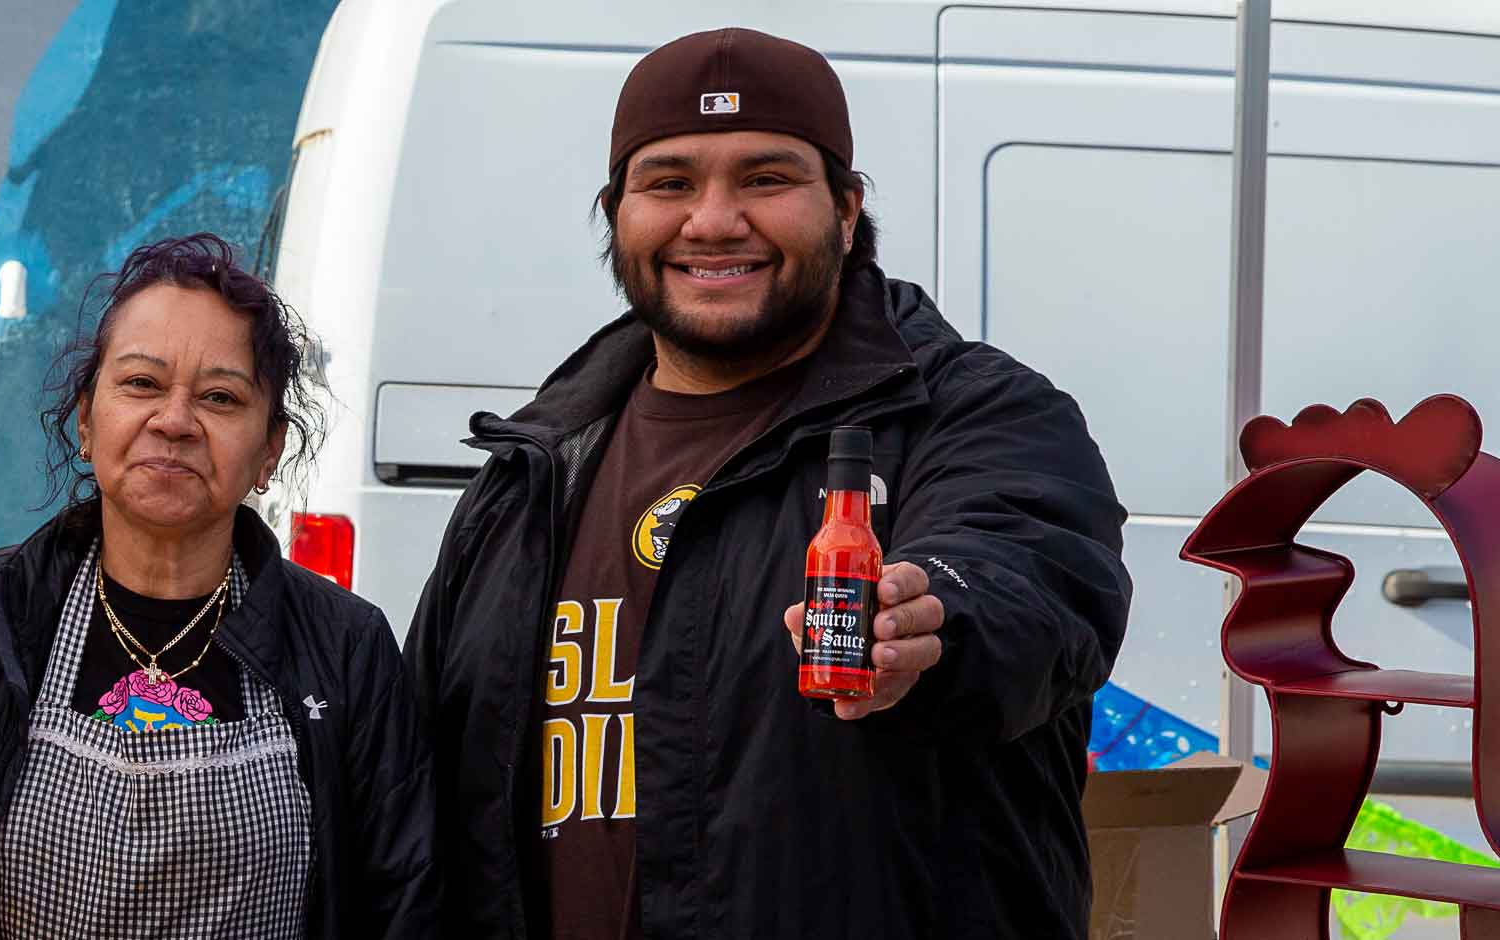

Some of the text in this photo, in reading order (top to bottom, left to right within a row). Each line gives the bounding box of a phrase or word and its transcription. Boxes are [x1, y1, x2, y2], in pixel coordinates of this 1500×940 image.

[927, 557, 969, 589] HYVENT
[805, 608, 857, 632] Squirty
[821, 628, 866, 650] Sauce
